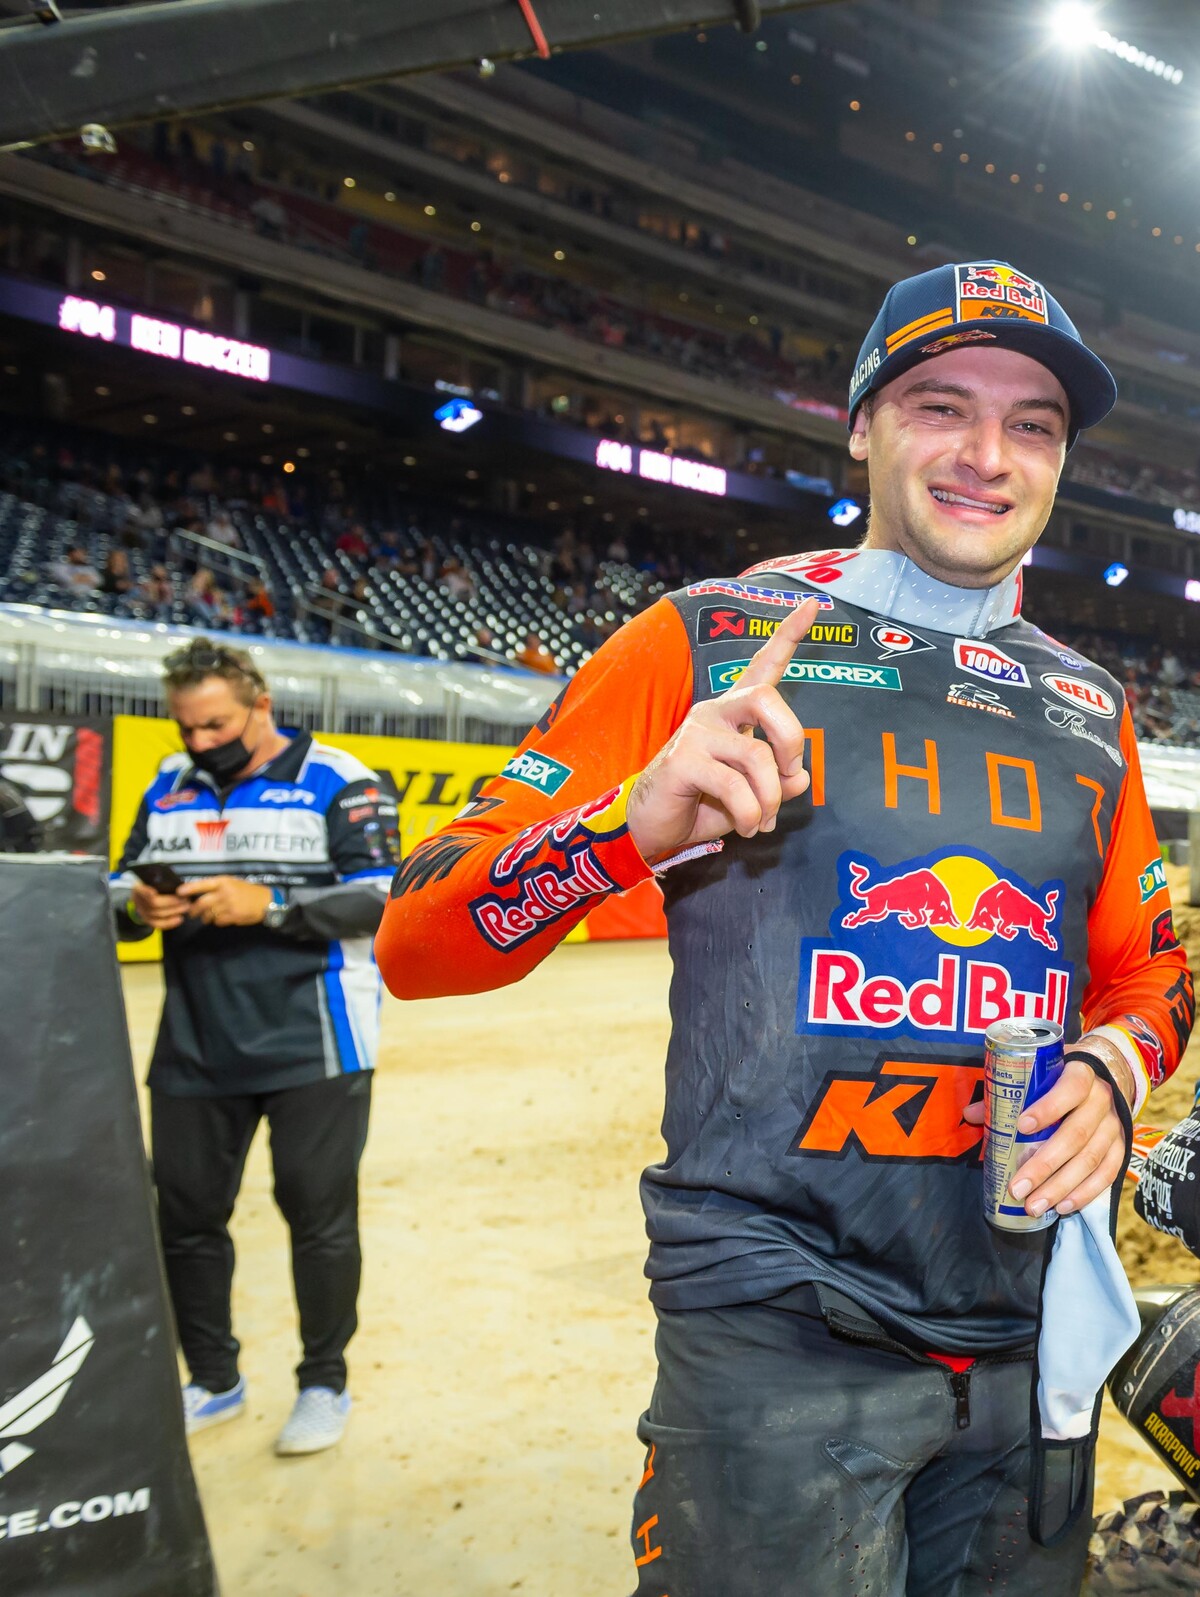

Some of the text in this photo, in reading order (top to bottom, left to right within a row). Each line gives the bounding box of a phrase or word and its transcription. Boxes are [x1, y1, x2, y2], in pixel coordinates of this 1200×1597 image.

[961, 281, 1044, 315] Red Bull
[687, 585, 835, 610] UNLIMITD
[964, 650, 1019, 681] 100%
[946, 696, 1016, 719] RENTHAL
[1053, 679, 1110, 712] BELL
[0, 722, 75, 762] IN
[225, 833, 321, 852] BATTERY
[476, 876, 562, 948] Red
[534, 848, 614, 911] Bull
[808, 949, 1070, 1034] Red Bull
[1002, 1088, 1022, 1098] 110
[797, 1060, 985, 1160] KT
[0, 1487, 151, 1540] E.COM
